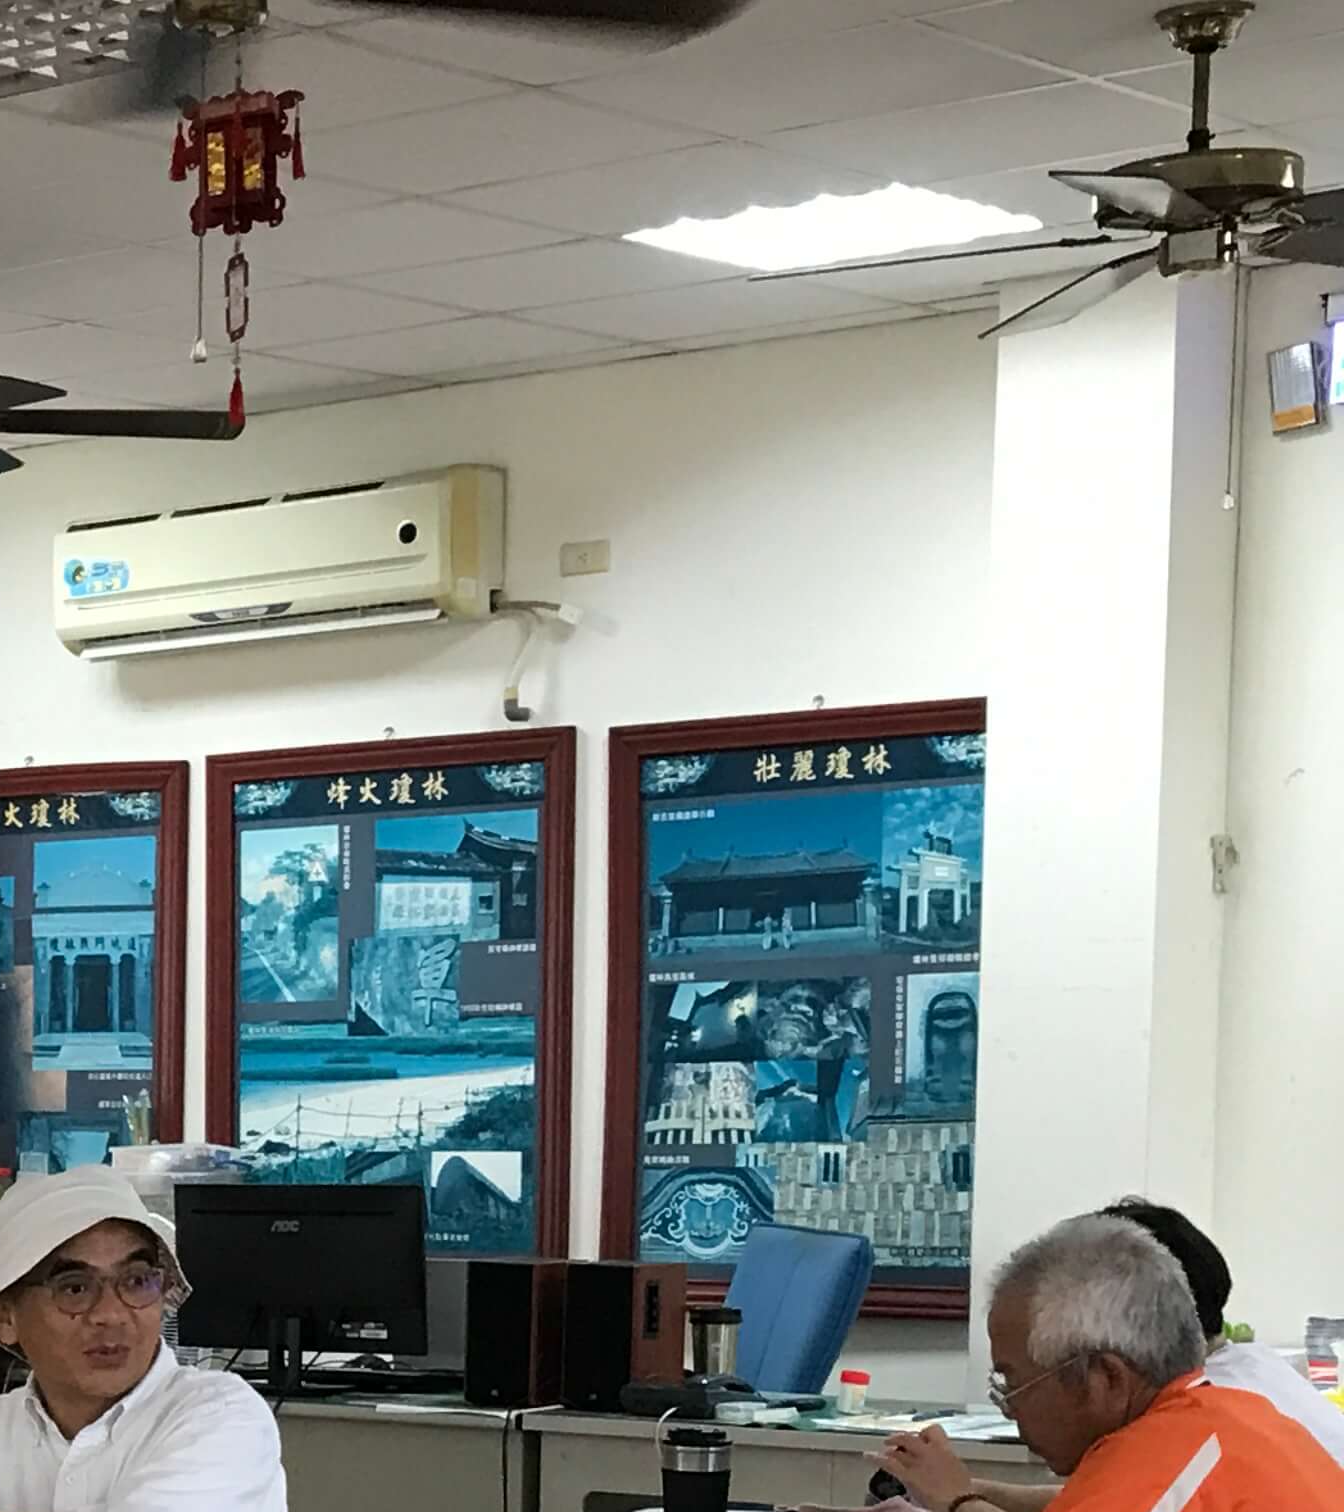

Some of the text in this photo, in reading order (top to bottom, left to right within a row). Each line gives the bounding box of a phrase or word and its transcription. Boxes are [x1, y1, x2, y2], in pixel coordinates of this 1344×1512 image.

[753, 744, 892, 783] 壯麗瓊林
[327, 769, 449, 810] 烽火瓊林
[412, 938, 457, 1028] 軍
